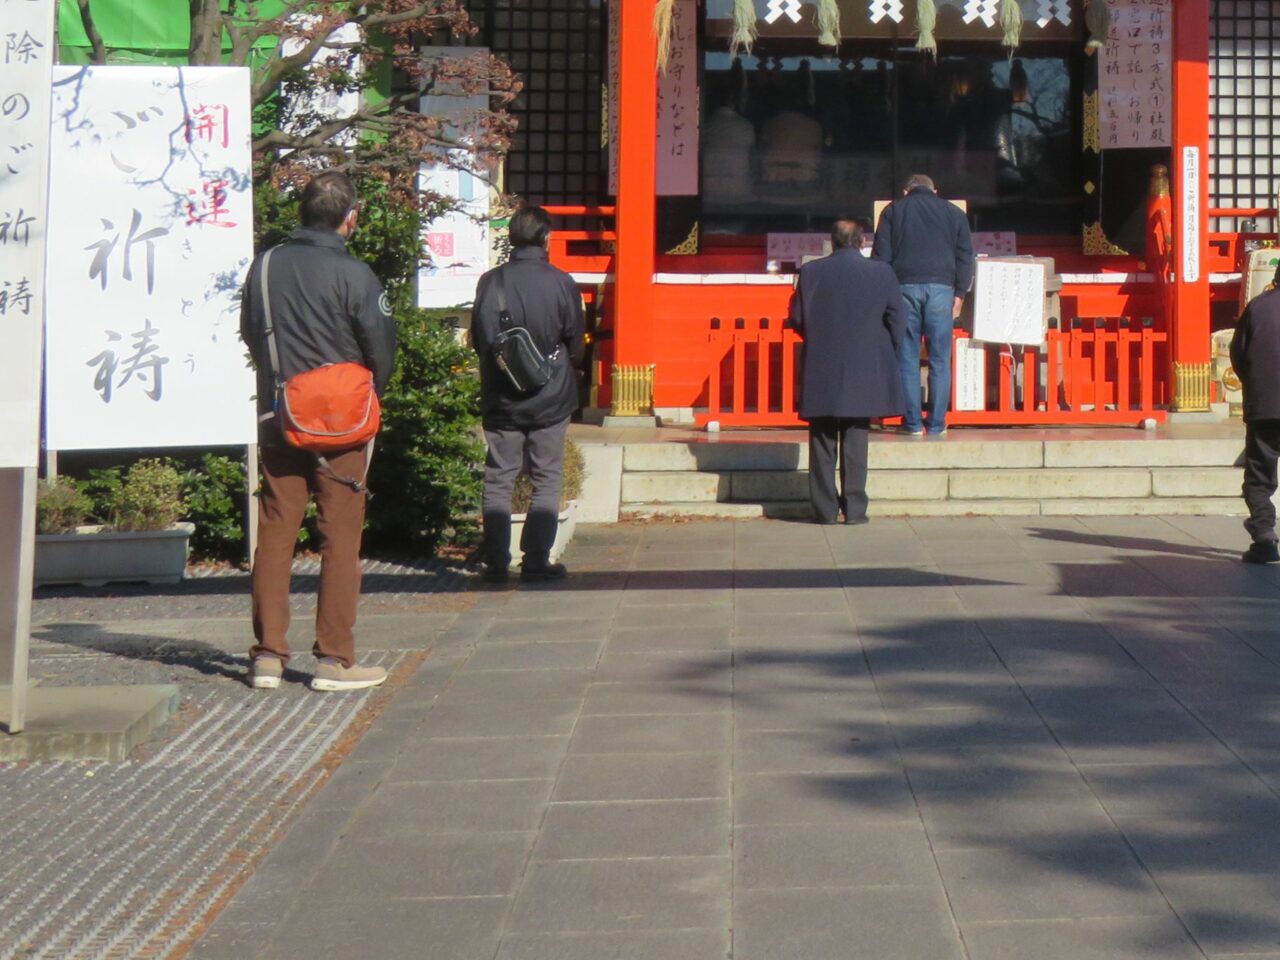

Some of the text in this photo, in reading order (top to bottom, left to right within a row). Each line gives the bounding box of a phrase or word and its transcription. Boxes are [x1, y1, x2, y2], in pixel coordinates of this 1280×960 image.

[185, 103, 238, 228] 開運
[84, 105, 170, 404] ご祈祷
[181, 238, 196, 374] きとう
